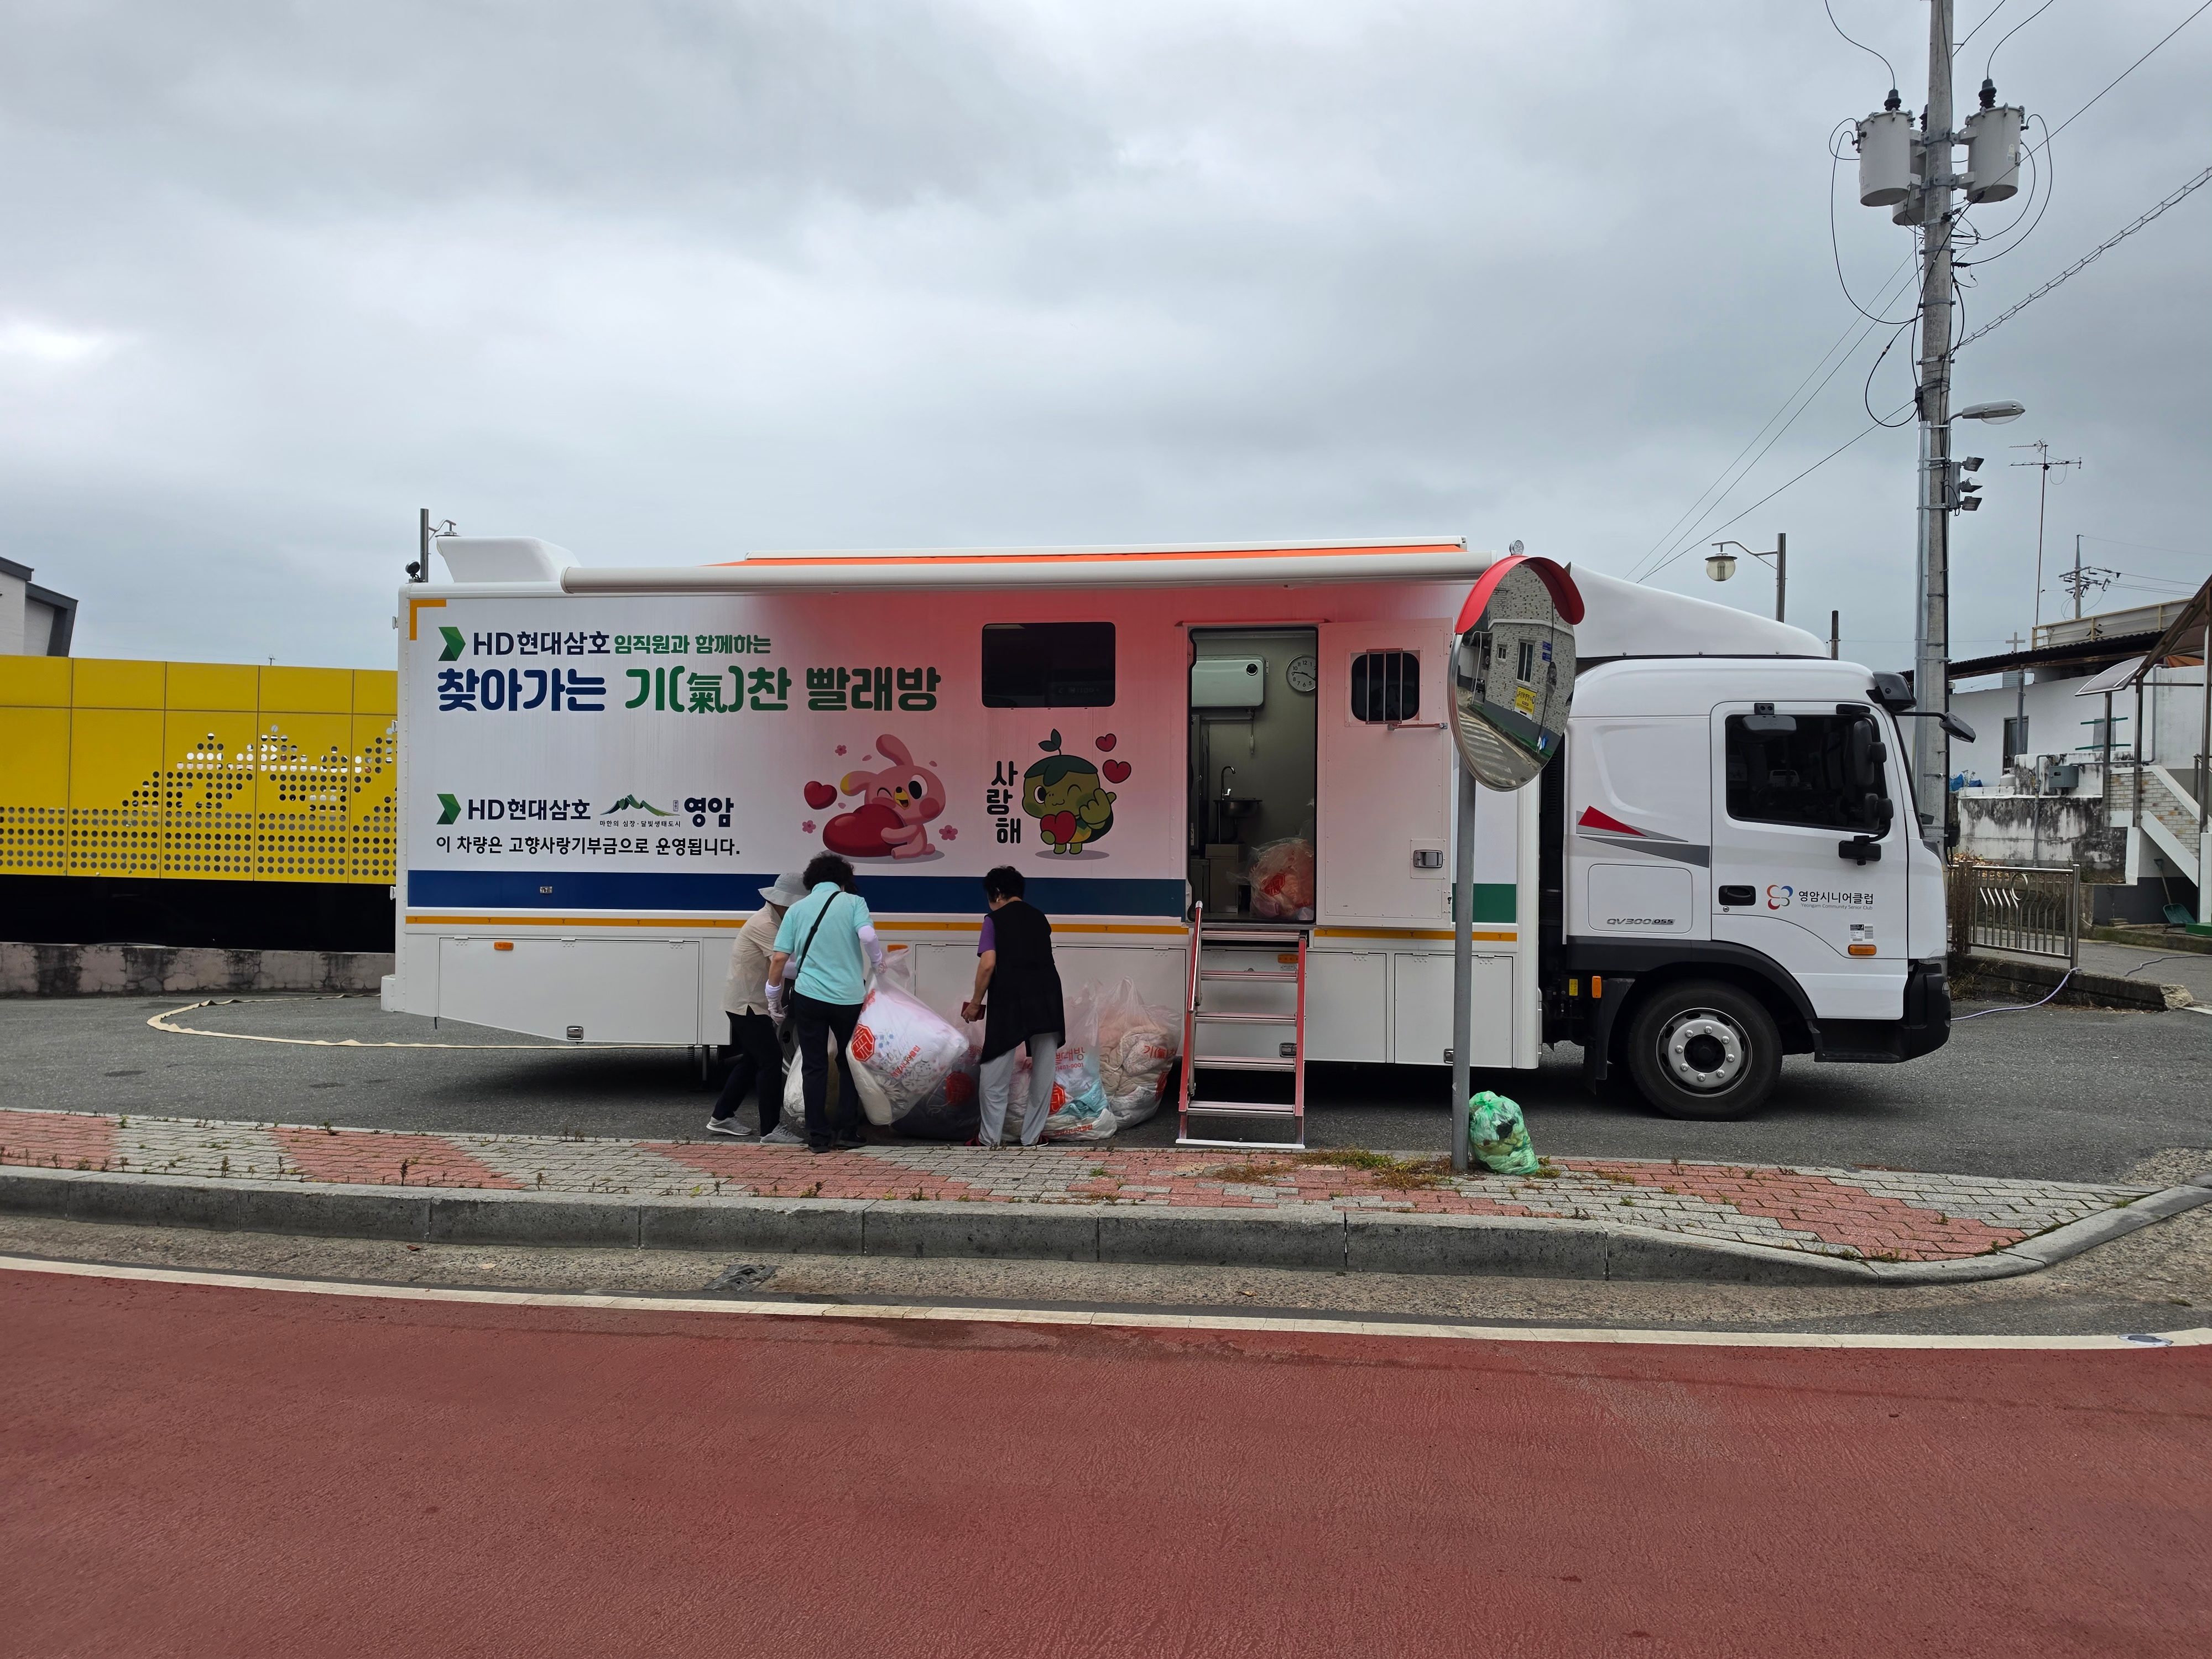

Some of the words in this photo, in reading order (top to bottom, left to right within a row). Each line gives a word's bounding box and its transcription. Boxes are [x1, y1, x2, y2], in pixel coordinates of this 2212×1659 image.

[473, 631, 611, 655] HD현대삼호
[614, 635, 690, 654] 임직원과
[695, 634, 771, 654] 함께하는
[437, 668, 607, 712] 찾아가는
[806, 666, 941, 712] 빨래방
[468, 799, 591, 821] HD현대삼호
[684, 797, 734, 827] 영암
[987, 760, 1021, 844] 사랑해
[436, 836, 450, 853] 이
[457, 836, 503, 854] 차량은
[509, 836, 649, 855] 고향사랑기부금으로
[655, 838, 740, 856] 운영됩니다.
[1798, 891, 1874, 905] 영암시니어클럽
